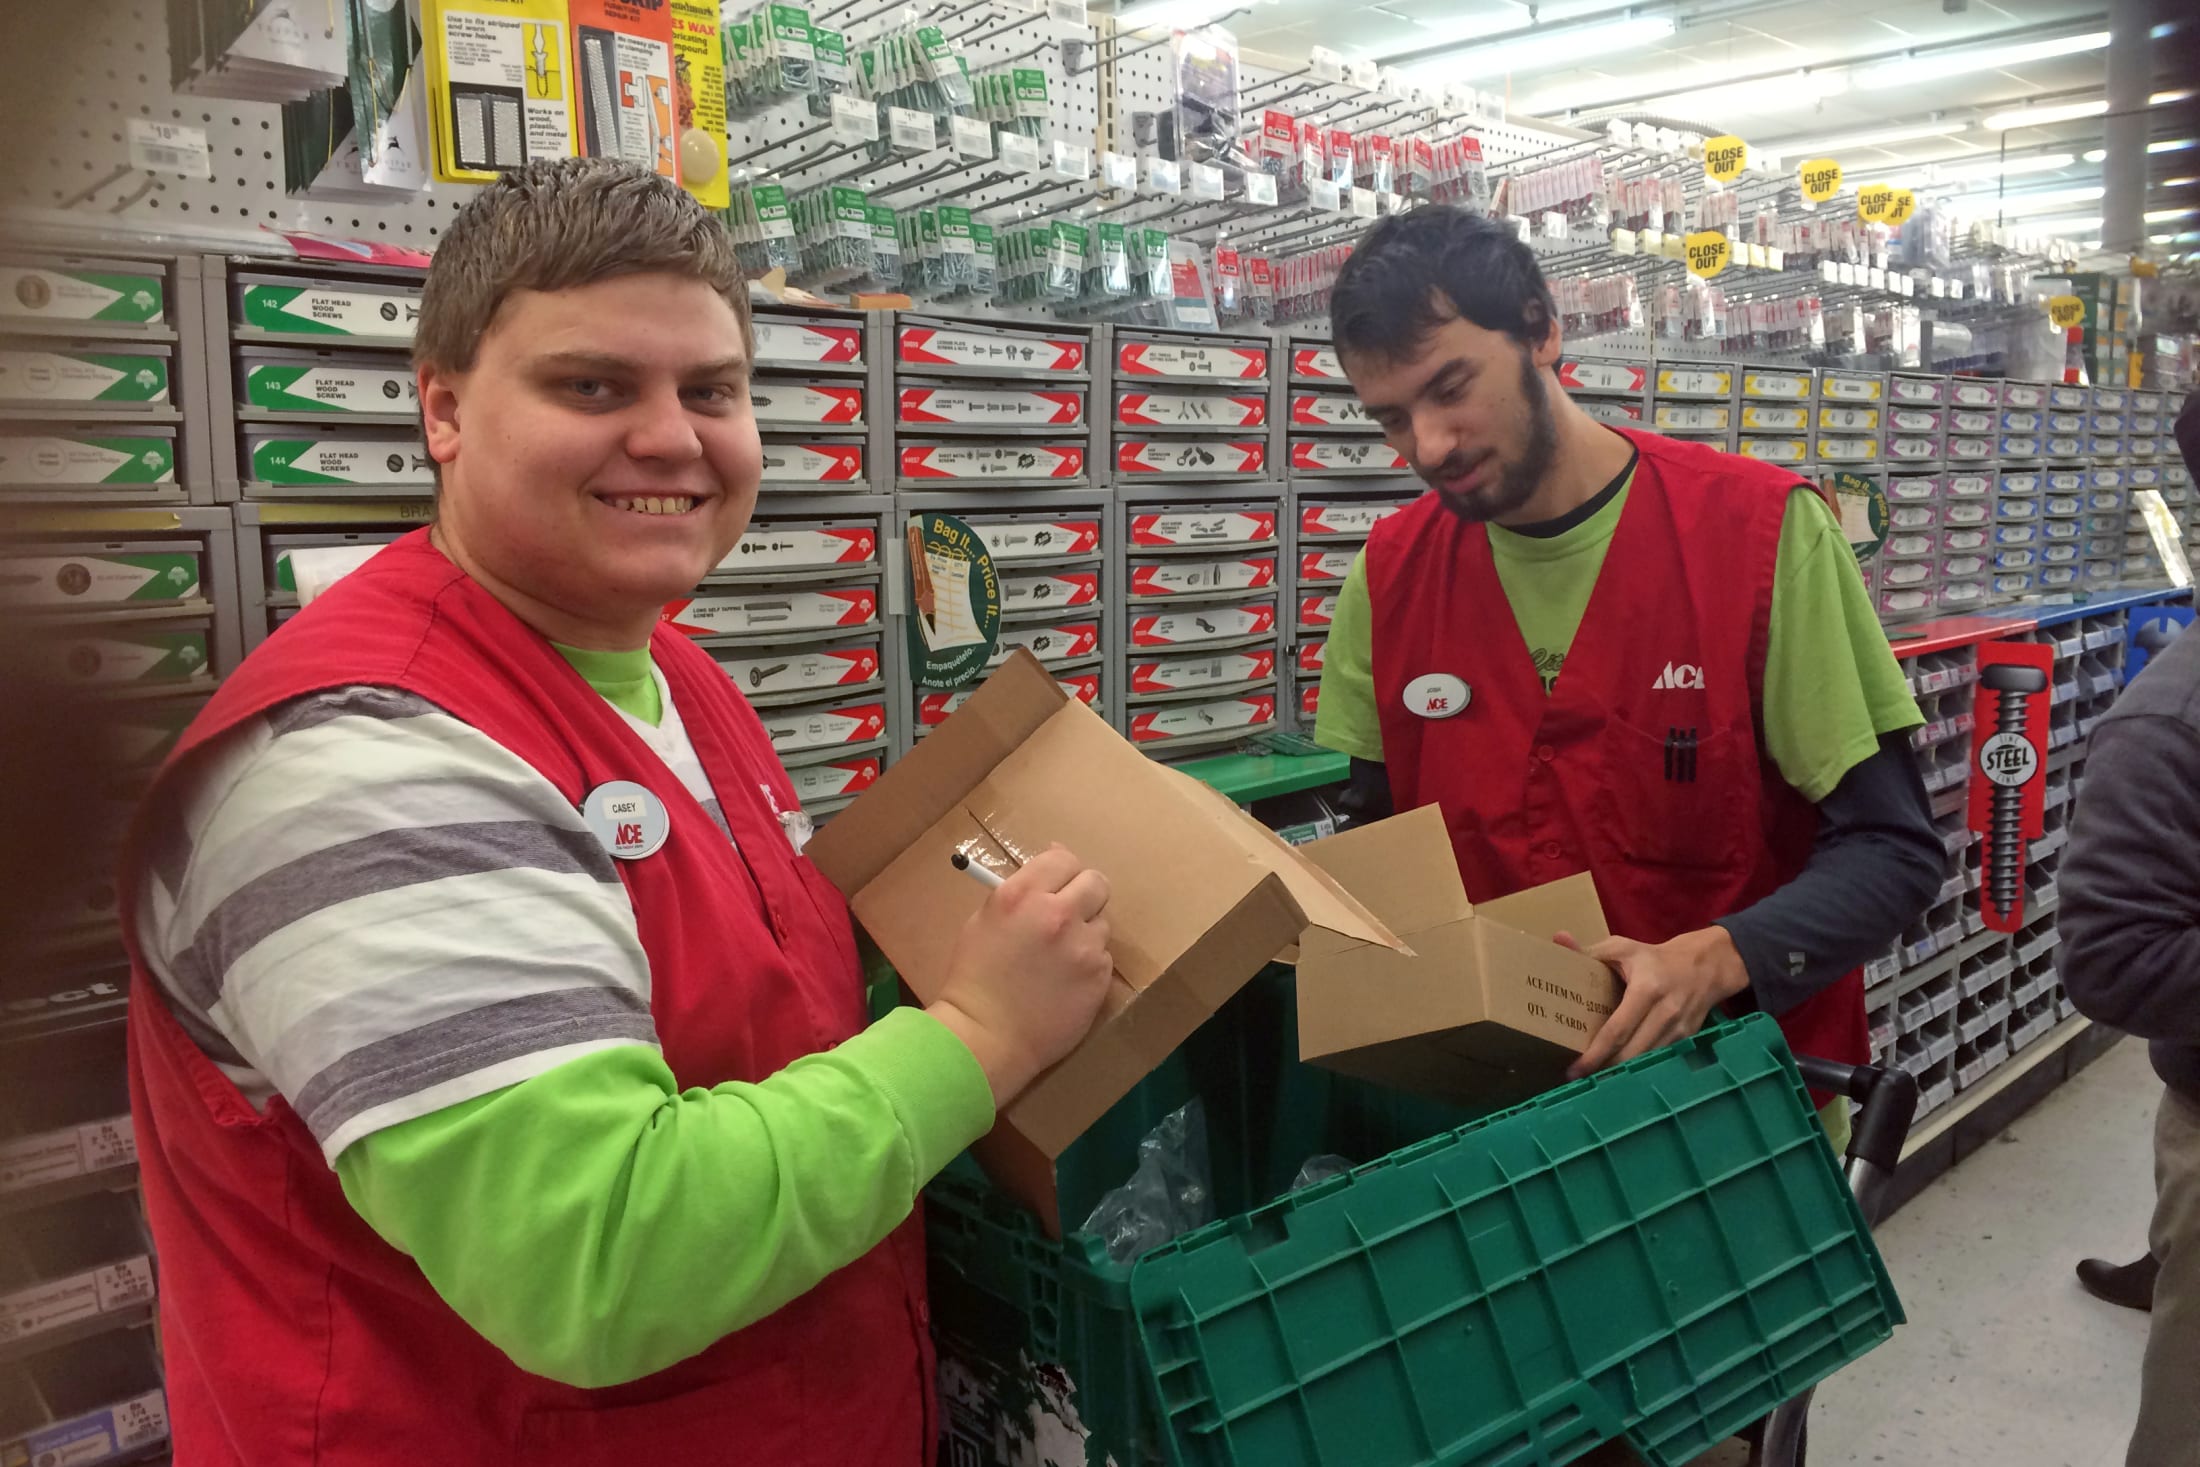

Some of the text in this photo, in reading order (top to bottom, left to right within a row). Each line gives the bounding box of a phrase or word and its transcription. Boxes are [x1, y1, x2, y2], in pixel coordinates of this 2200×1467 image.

[688, 21, 716, 36] WAX
[1707, 146, 1743, 163] CLOSE
[1714, 160, 1736, 174] OUT
[1804, 169, 1838, 184] CLOSE
[1811, 181, 1831, 194] OUT
[1861, 192, 1893, 206] CLOSE
[1866, 203, 1886, 215] OUT
[1689, 243, 1725, 258] CLOSE
[1696, 256, 1718, 270] OUT
[262, 299, 278, 308] 142
[313, 311, 343, 319] SCREWS
[265, 381, 281, 391] 143
[316, 392, 347, 400] SCREWS
[270, 457, 286, 466] 144
[933, 518, 959, 544] Bag
[977, 554, 996, 599] Price
[921, 676, 944, 687] Anote
[1427, 698, 1448, 710] ACE
[1986, 747, 2030, 770] STEEL
[612, 802, 636, 813] CASEY
[616, 822, 643, 846] ACE
[1527, 975, 1584, 1006] ACE ITEM NO.
[1528, 1002, 1547, 1018] QTY.
